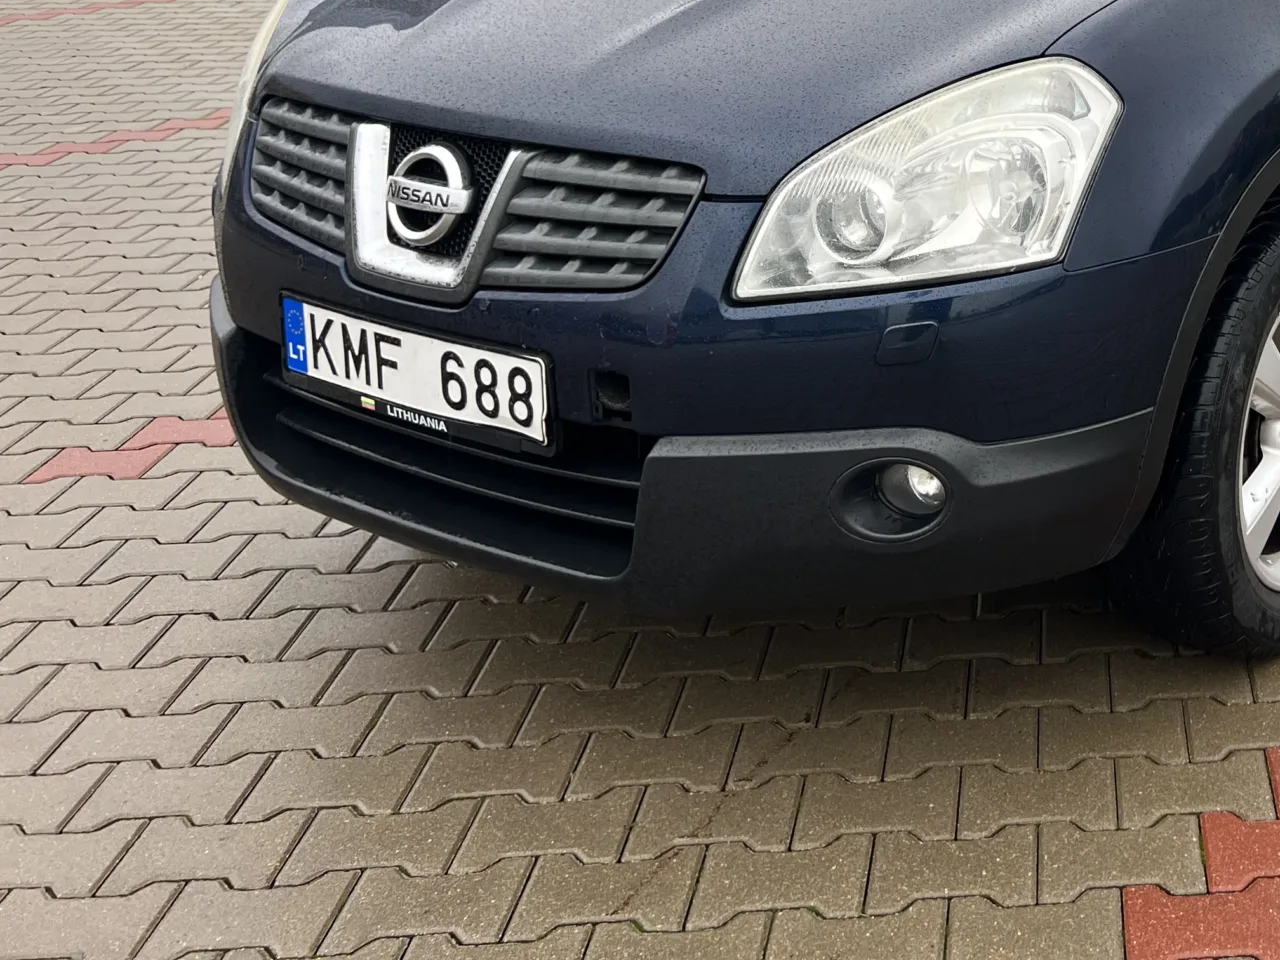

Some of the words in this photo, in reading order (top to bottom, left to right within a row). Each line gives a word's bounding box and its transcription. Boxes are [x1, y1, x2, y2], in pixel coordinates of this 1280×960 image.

[387, 182, 450, 208] NISSAN
[289, 341, 306, 361] LT
[309, 312, 402, 390] KMF
[440, 350, 534, 428] 688
[386, 404, 448, 433] LITHUANIA
